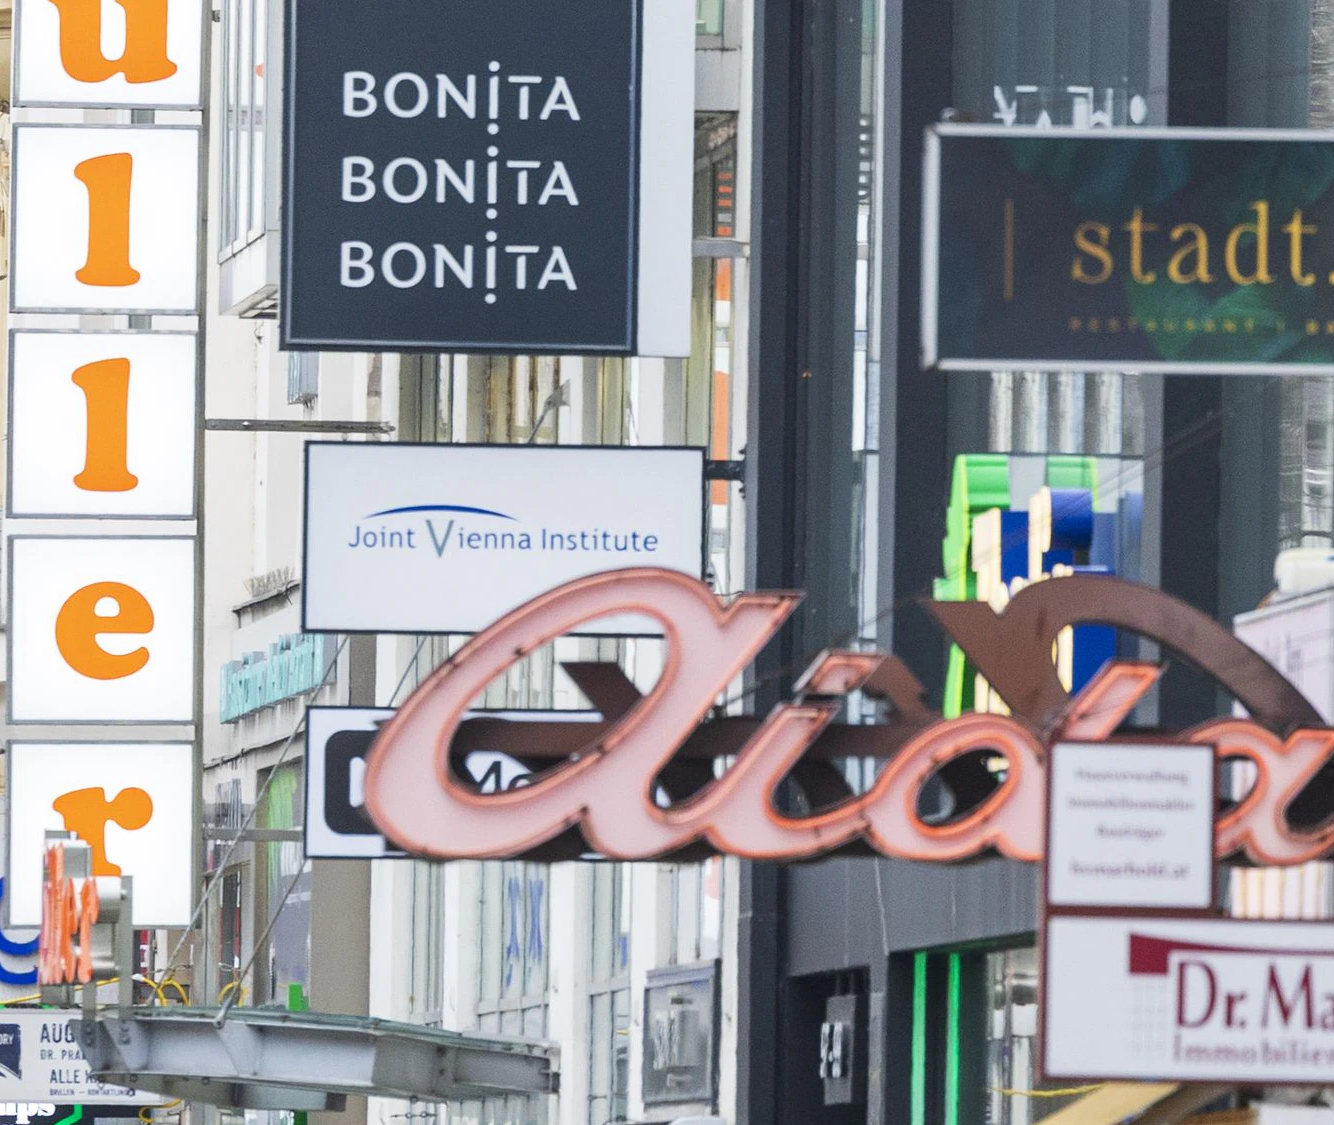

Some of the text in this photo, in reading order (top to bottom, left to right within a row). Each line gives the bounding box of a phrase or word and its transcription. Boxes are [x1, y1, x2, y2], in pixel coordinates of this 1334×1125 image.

[343, 61, 581, 123] BONITA
[341, 146, 579, 207] BONITA
[339, 231, 578, 292] BONITA
[348, 519, 659, 558] Joint Vienna Institute
[1175, 960, 1248, 1029] Dr.
[40, 1022, 76, 1044] AUG
[49, 1069, 81, 1085] ALLE
